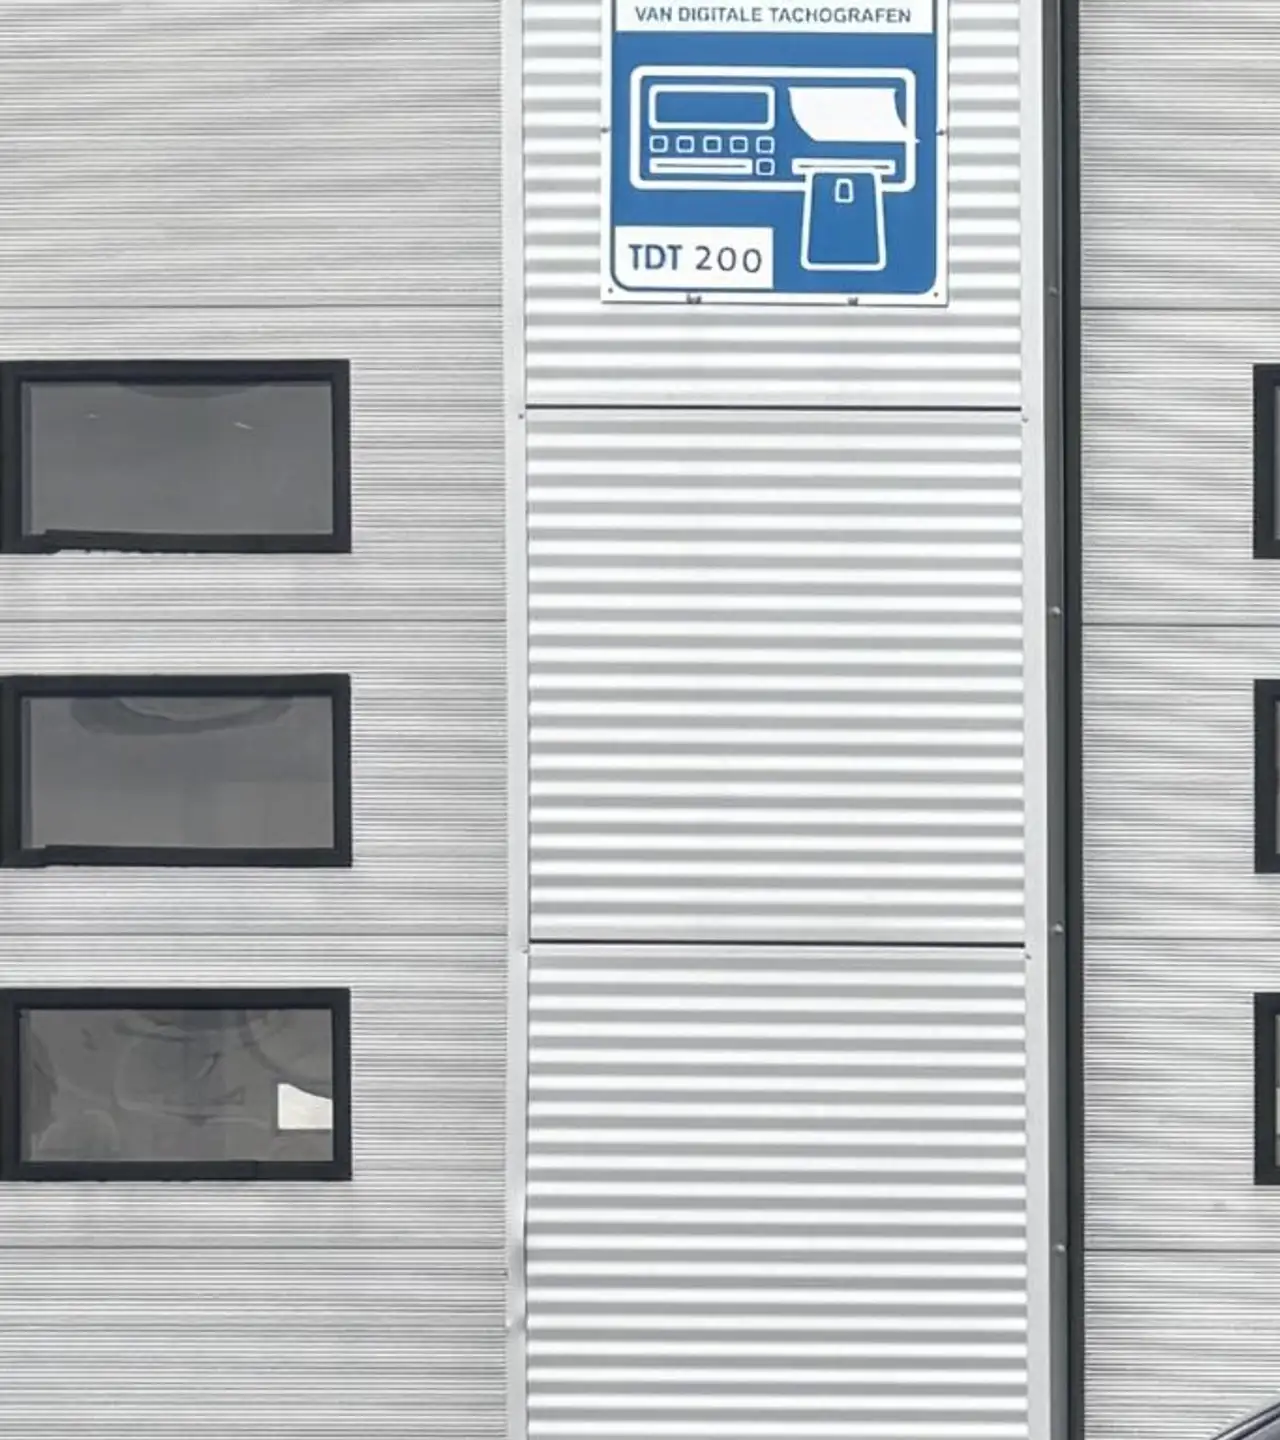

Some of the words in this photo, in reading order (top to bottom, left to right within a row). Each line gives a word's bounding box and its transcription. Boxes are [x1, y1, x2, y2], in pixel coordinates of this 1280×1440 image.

[634, 6, 673, 22] VAN
[678, 6, 763, 22] DIGITALE
[768, 7, 911, 23] TACHOGRAFEN
[627, 243, 683, 271] TDT
[694, 245, 762, 273] 200
